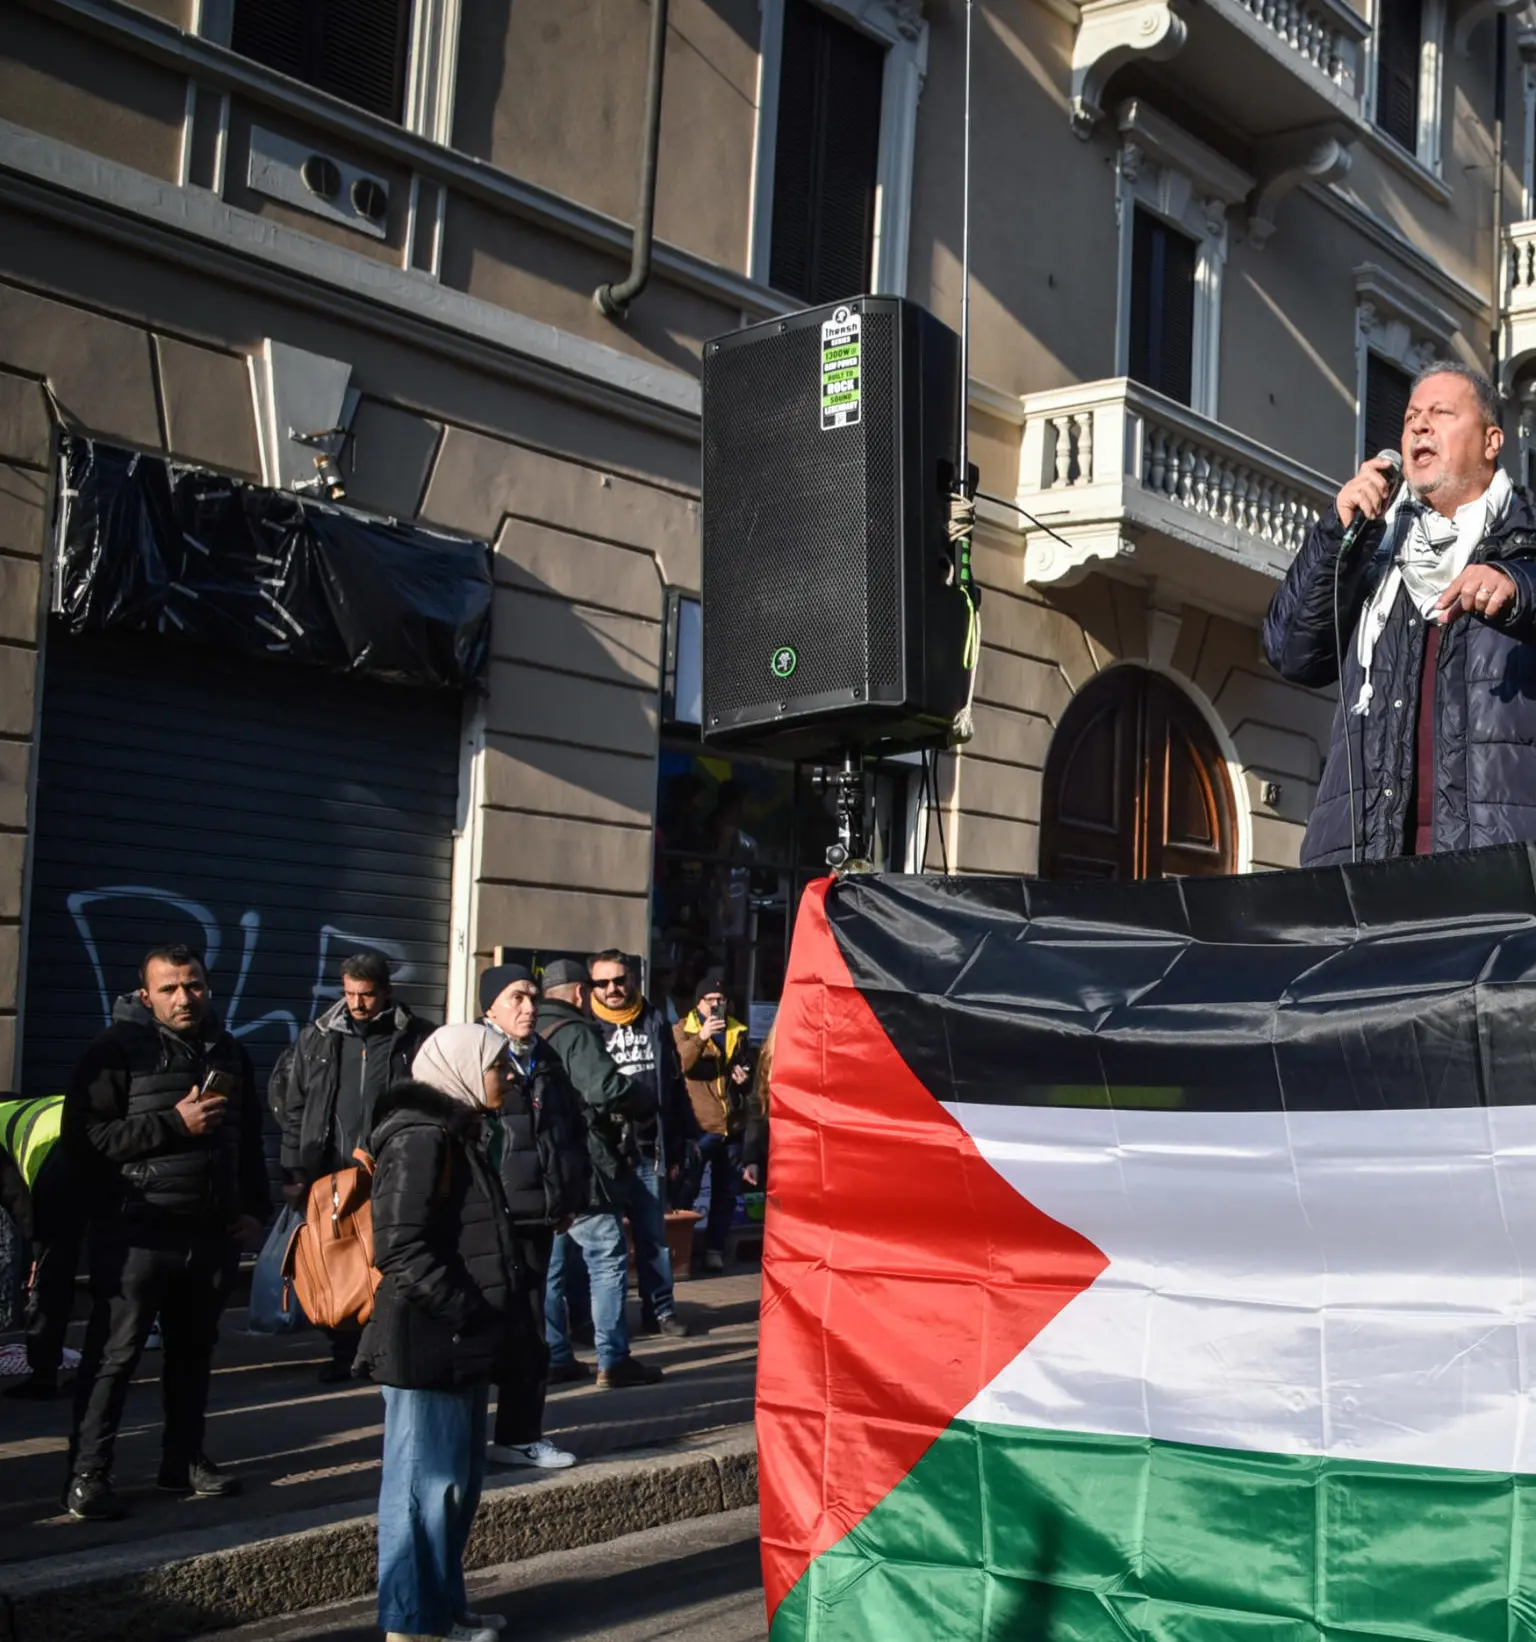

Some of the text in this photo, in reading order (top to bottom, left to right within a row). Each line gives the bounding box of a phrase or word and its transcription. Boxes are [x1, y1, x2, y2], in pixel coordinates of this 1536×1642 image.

[825, 348, 850, 360] 1300W
[827, 379, 854, 395] ROCK
[830, 393, 852, 404] SOUND
